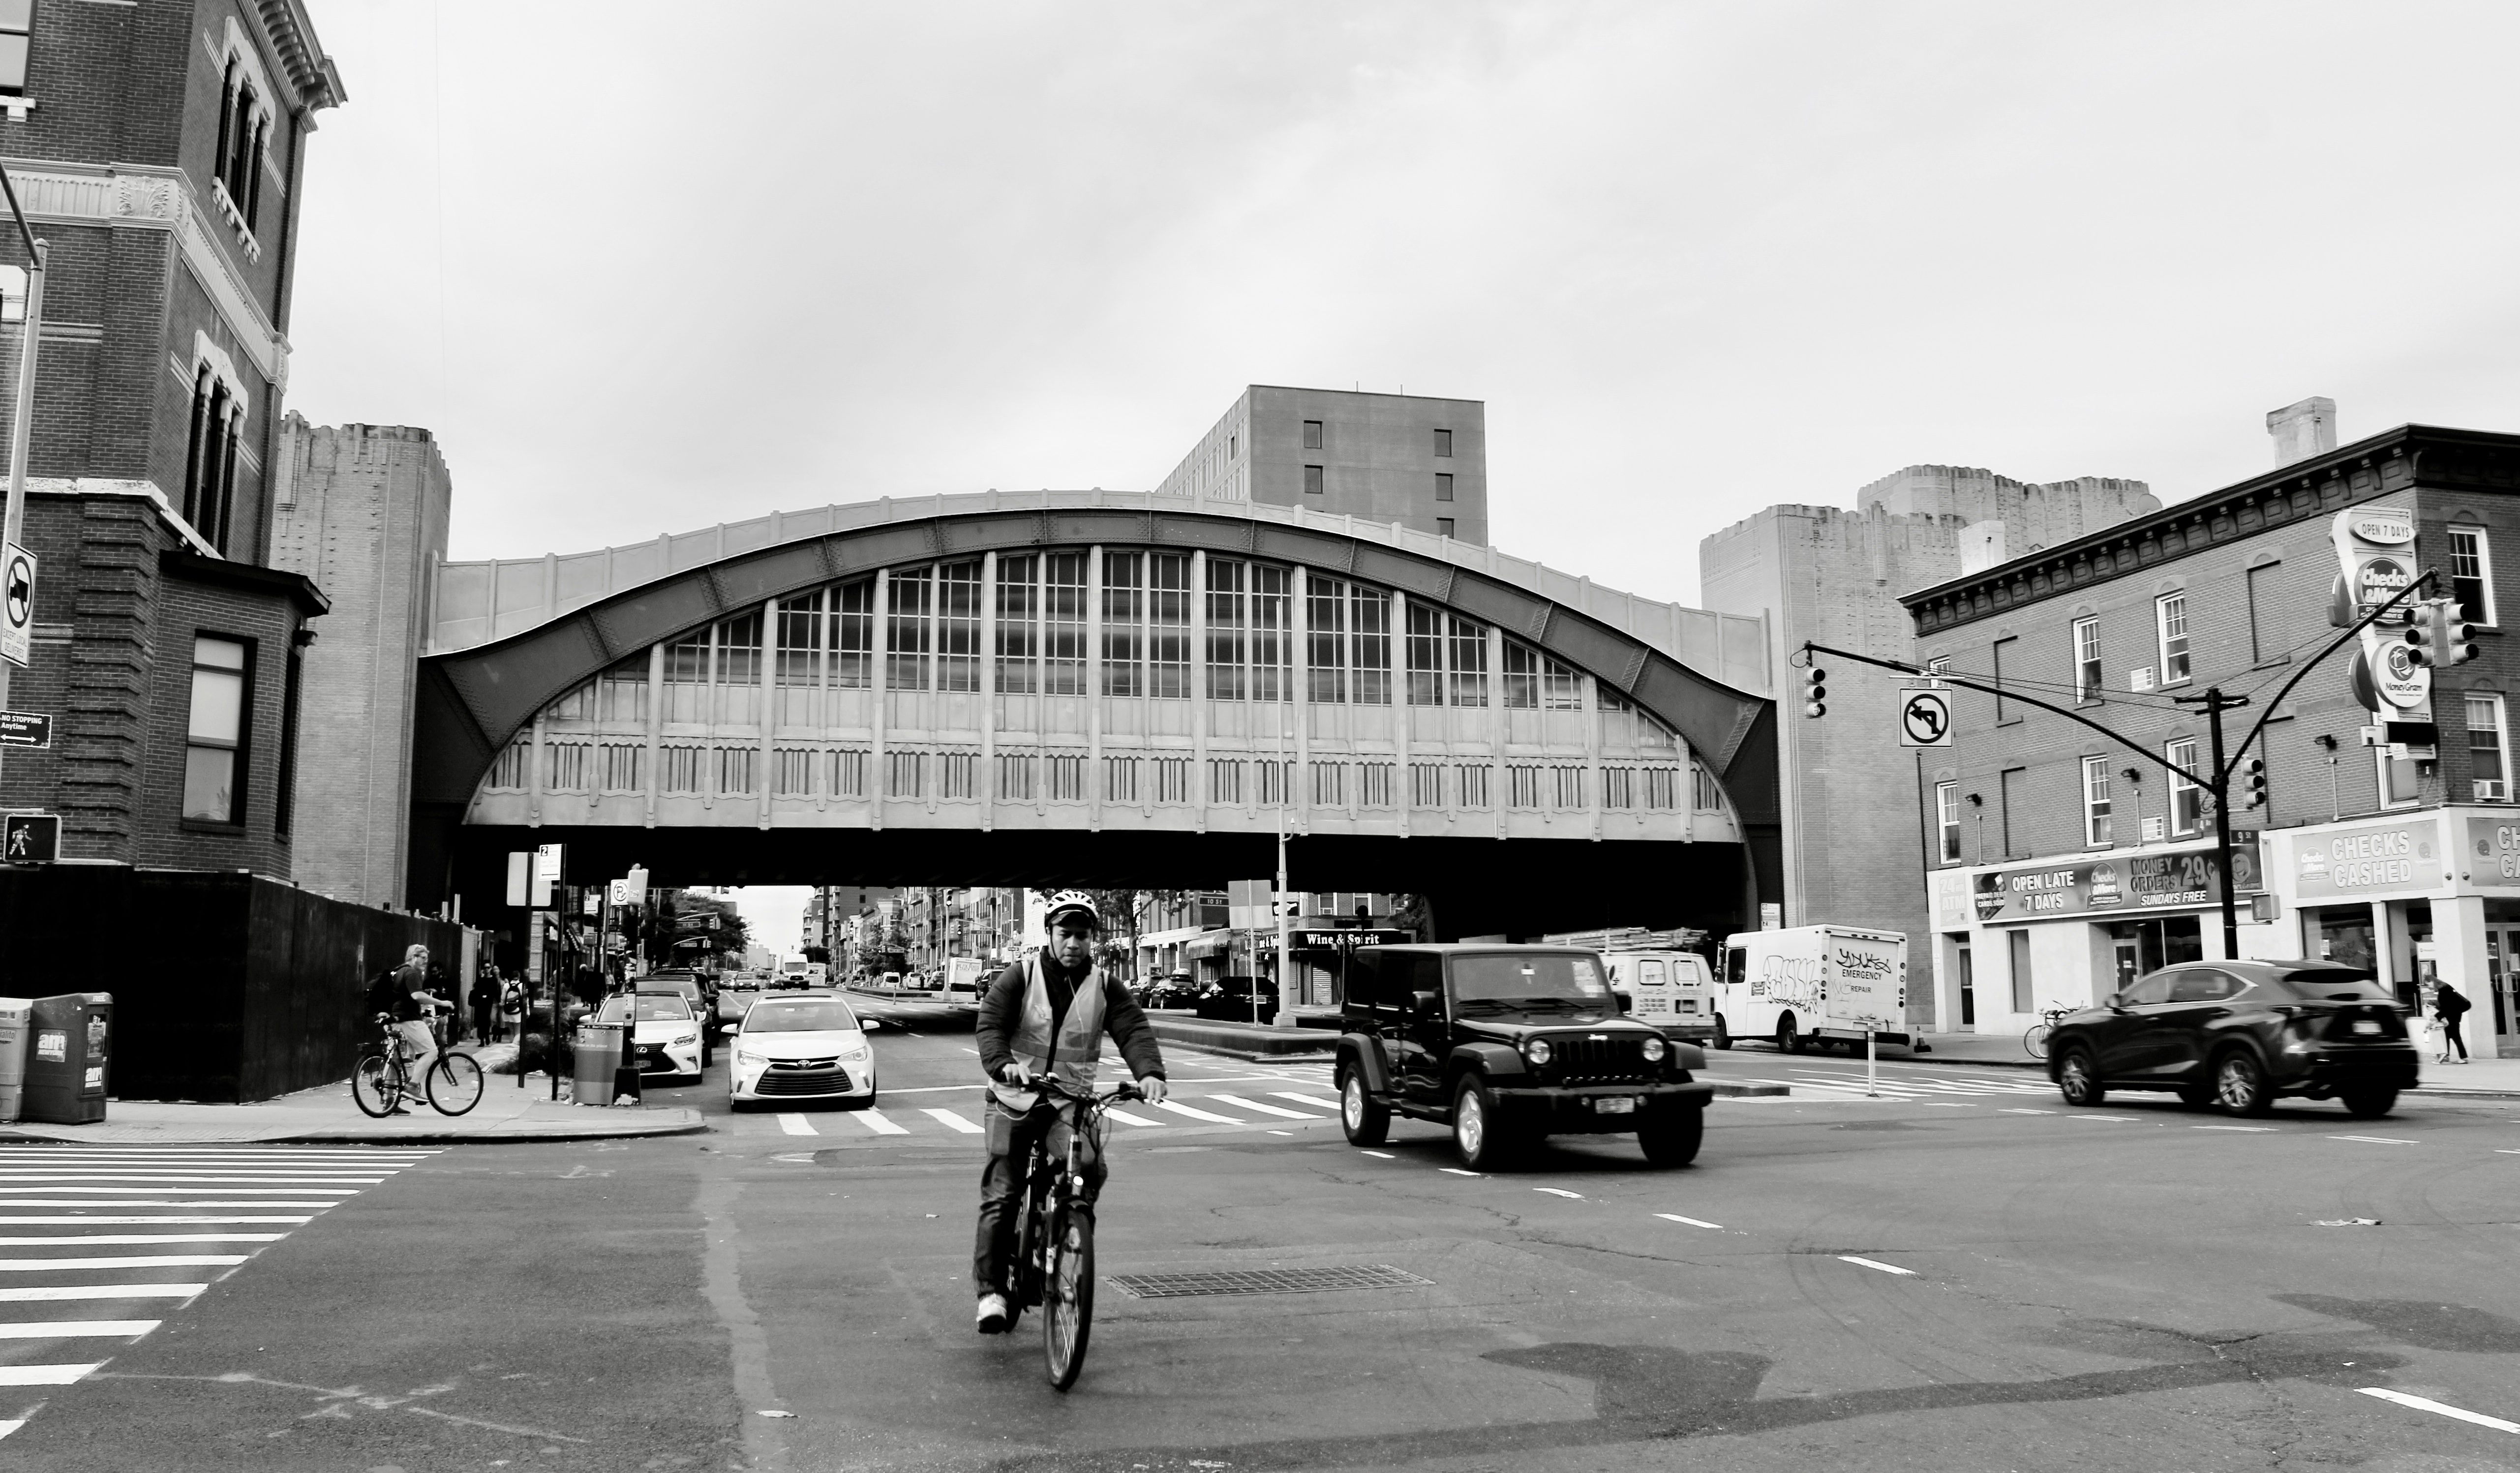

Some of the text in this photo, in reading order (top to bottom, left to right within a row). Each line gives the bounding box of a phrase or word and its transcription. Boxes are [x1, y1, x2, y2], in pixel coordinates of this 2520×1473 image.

[2362, 524, 2409, 538] OPEN 7 DAYS
[2362, 568, 2408, 587] Checks
[2386, 683, 2422, 692] MoneyGram
[1, 722, 27, 730] Anytime
[12, 716, 42, 724] STOPPING
[2238, 832, 2243, 842] 9
[542, 846, 547, 856] 2
[2331, 831, 2411, 861] CHECKS
[2131, 857, 2172, 875] MONEY
[2334, 859, 2412, 888] CASHED
[2012, 870, 2074, 892] OPEN LATE
[2092, 870, 2116, 883] Checks
[2131, 874, 2177, 892] ORDERS
[1939, 877, 1955, 894] 24
[1942, 895, 1965, 910] ATM
[2025, 892, 2063, 910] 7 DAYS
[2141, 890, 2207, 906] SUNDAYS FREE
[1306, 934, 1379, 945] Wine & Spirit
[1842, 969, 1882, 980] EMERGENCY
[38, 1034, 65, 1050] am
[86, 1067, 102, 1082] am
